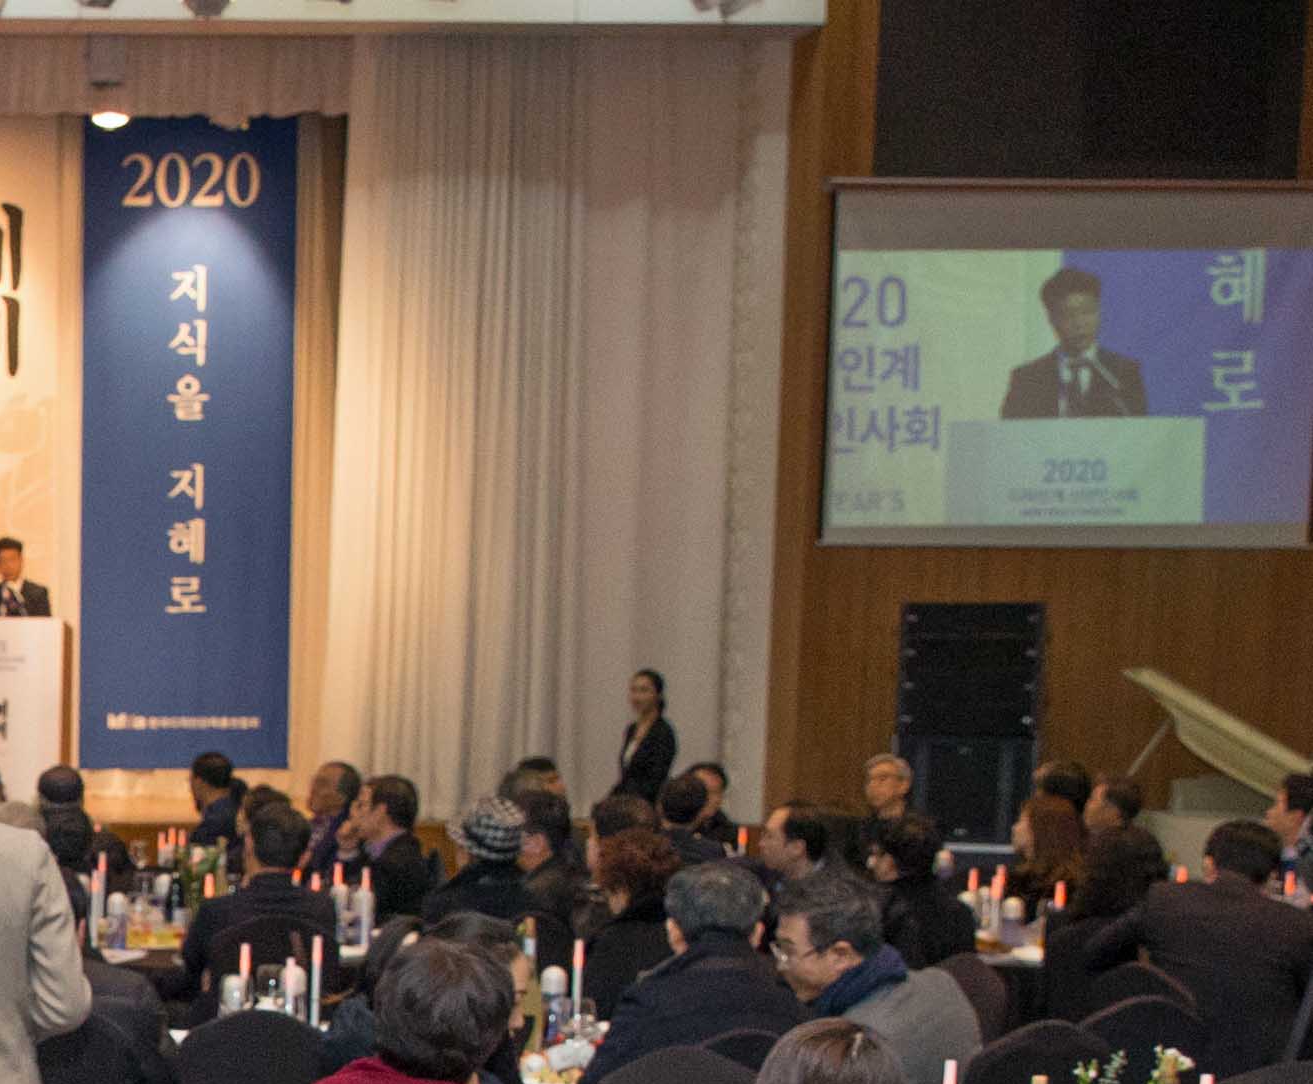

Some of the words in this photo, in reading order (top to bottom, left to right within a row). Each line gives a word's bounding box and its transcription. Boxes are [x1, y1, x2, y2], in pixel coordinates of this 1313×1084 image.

[122, 152, 262, 209] 2020
[841, 274, 907, 329] 20
[837, 343, 921, 394] 인계
[1042, 457, 1108, 484] 2020
